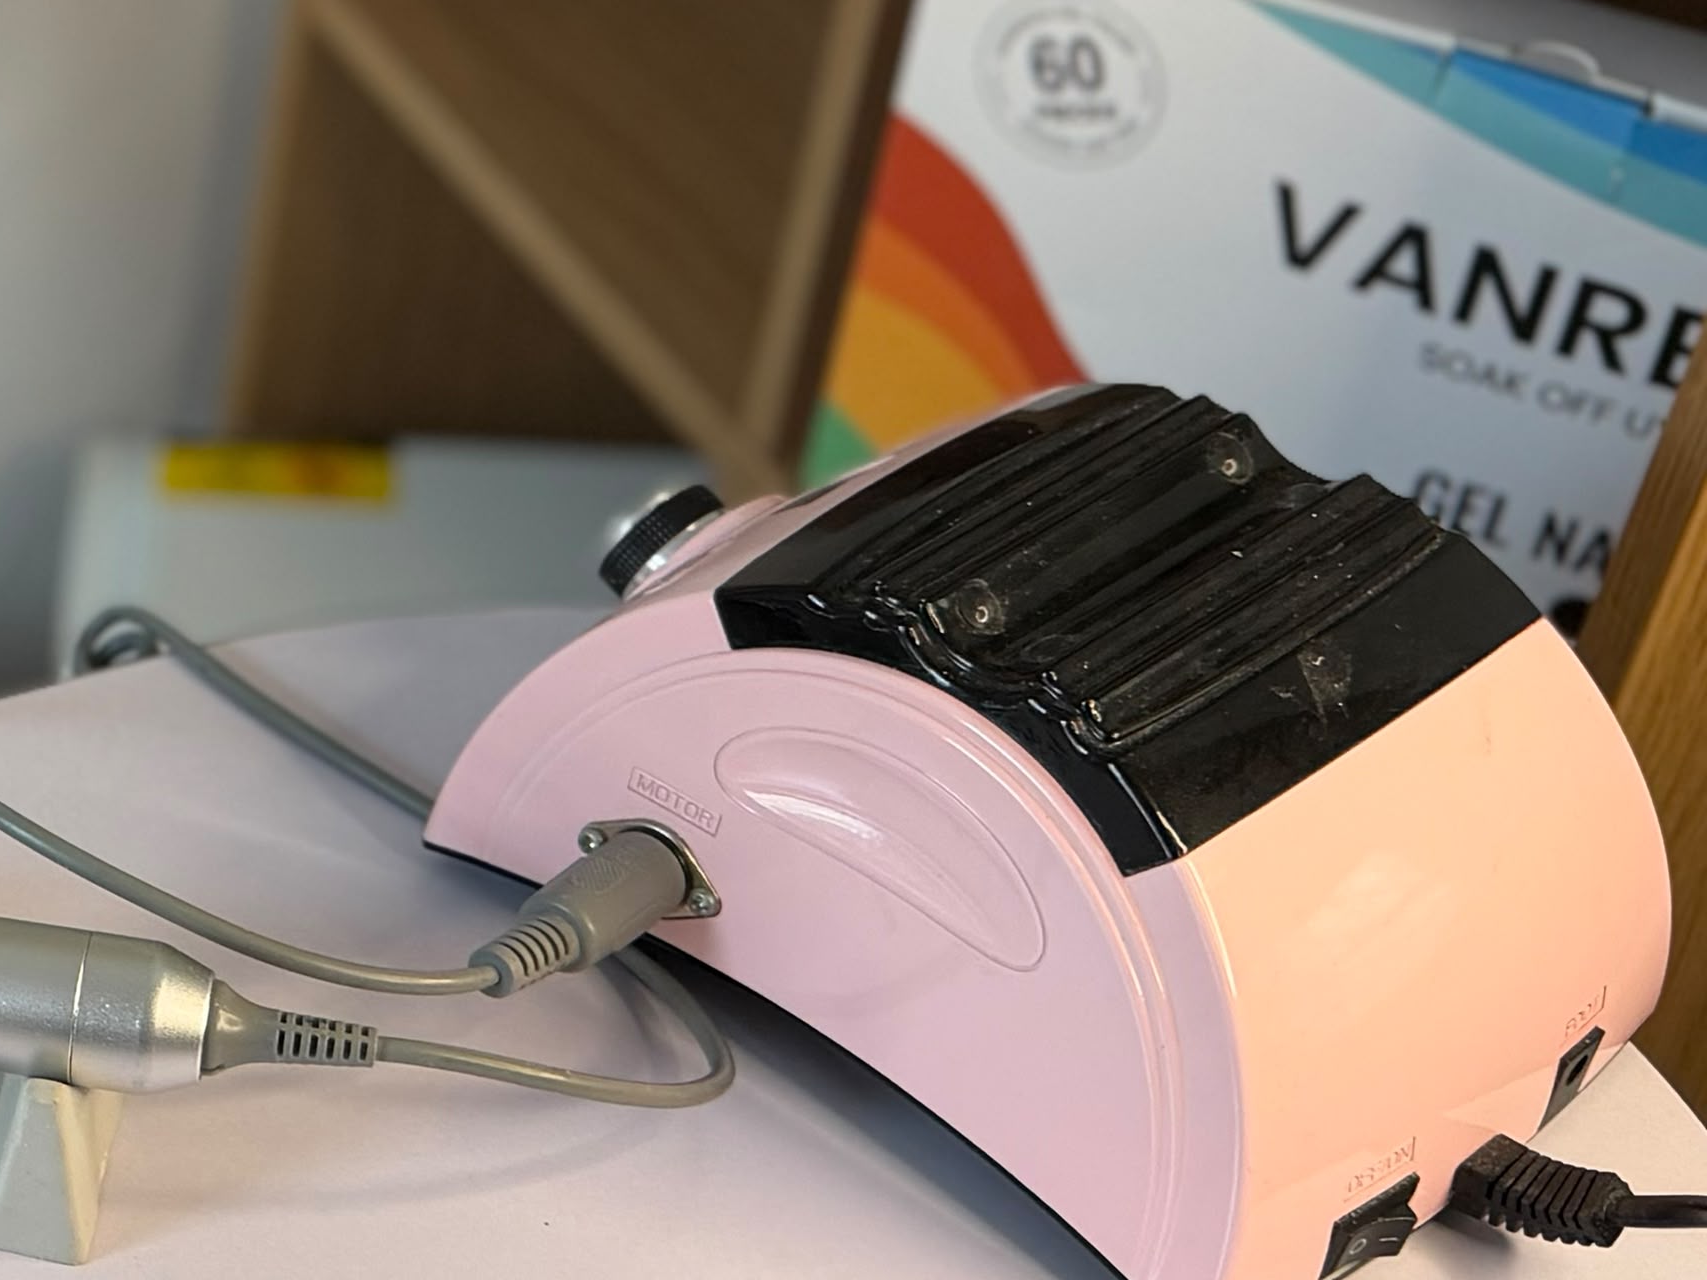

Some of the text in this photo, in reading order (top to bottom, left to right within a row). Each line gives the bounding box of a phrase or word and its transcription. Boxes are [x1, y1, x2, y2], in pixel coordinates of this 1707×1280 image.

[1028, 34, 1107, 95] 60
[1420, 340, 1527, 400] SOAK
[1537, 380, 1615, 423] OFF
[1412, 467, 1509, 551] GEL
[635, 773, 715, 829] MOTOR
